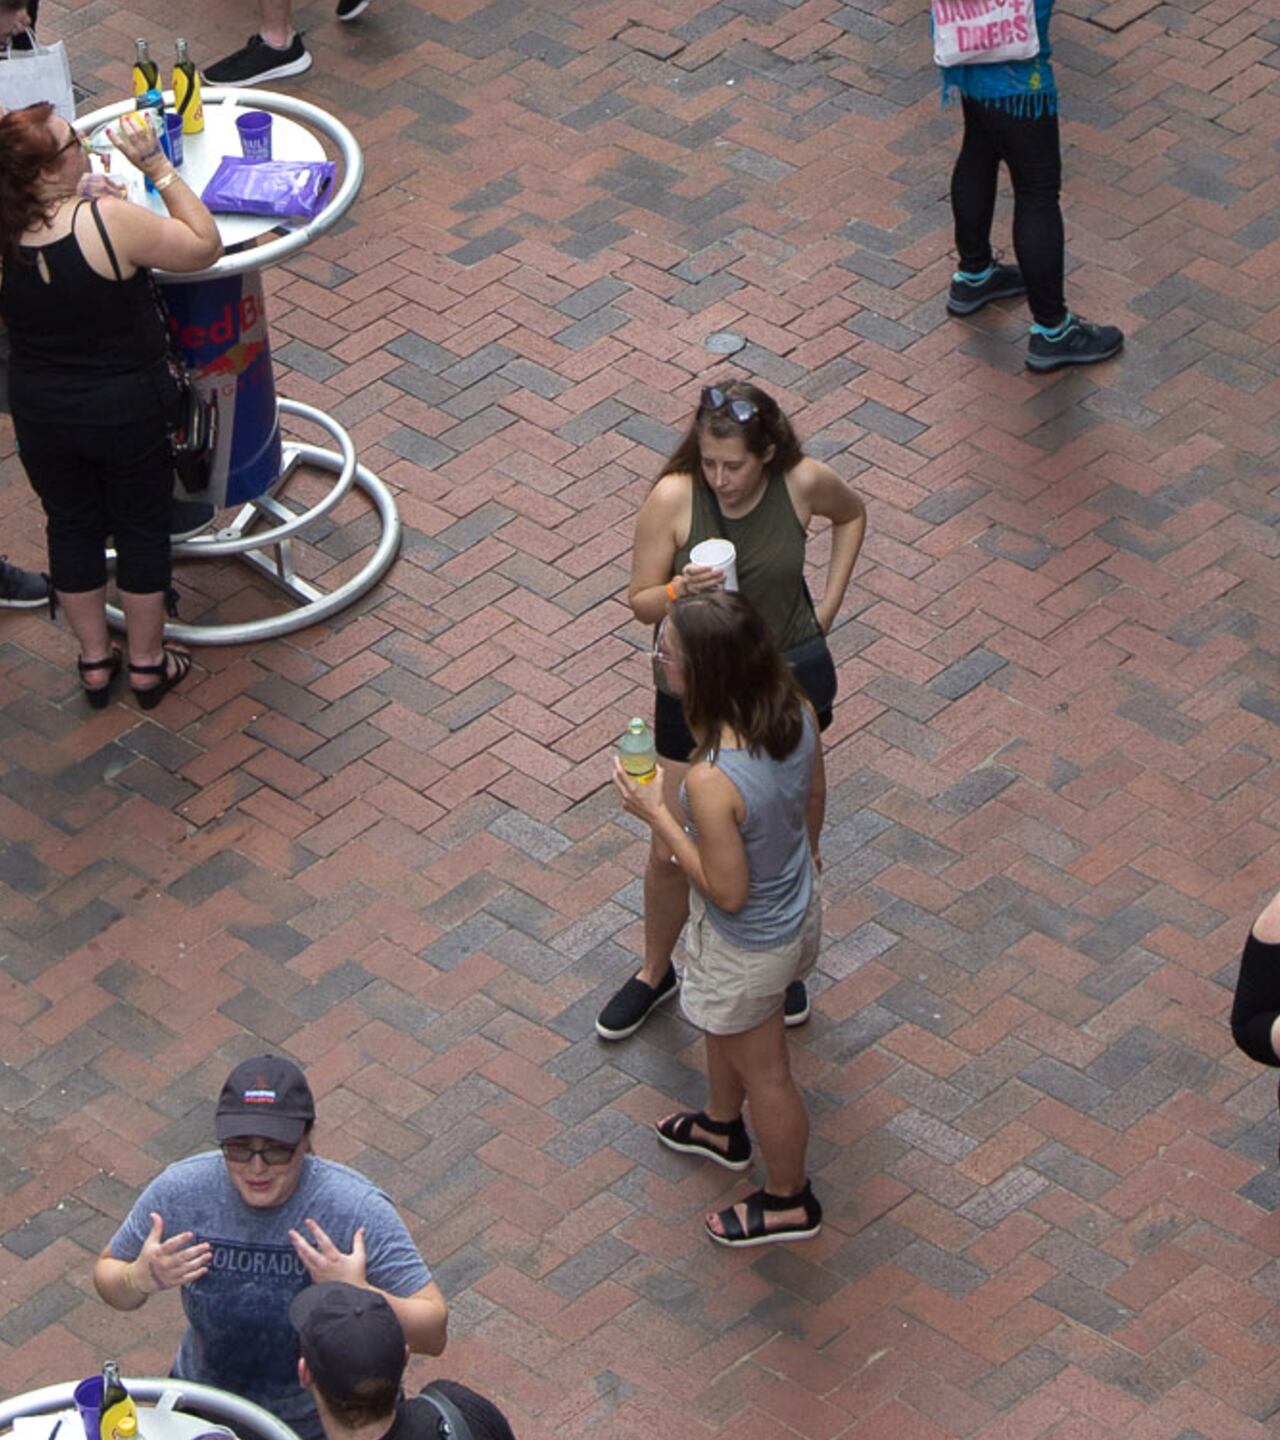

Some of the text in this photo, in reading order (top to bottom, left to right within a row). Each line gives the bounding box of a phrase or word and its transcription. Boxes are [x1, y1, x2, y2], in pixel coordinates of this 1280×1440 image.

[956, 14, 1029, 53] DREGS
[172, 302, 234, 348] ed
[210, 1245, 307, 1277] OLORADO
